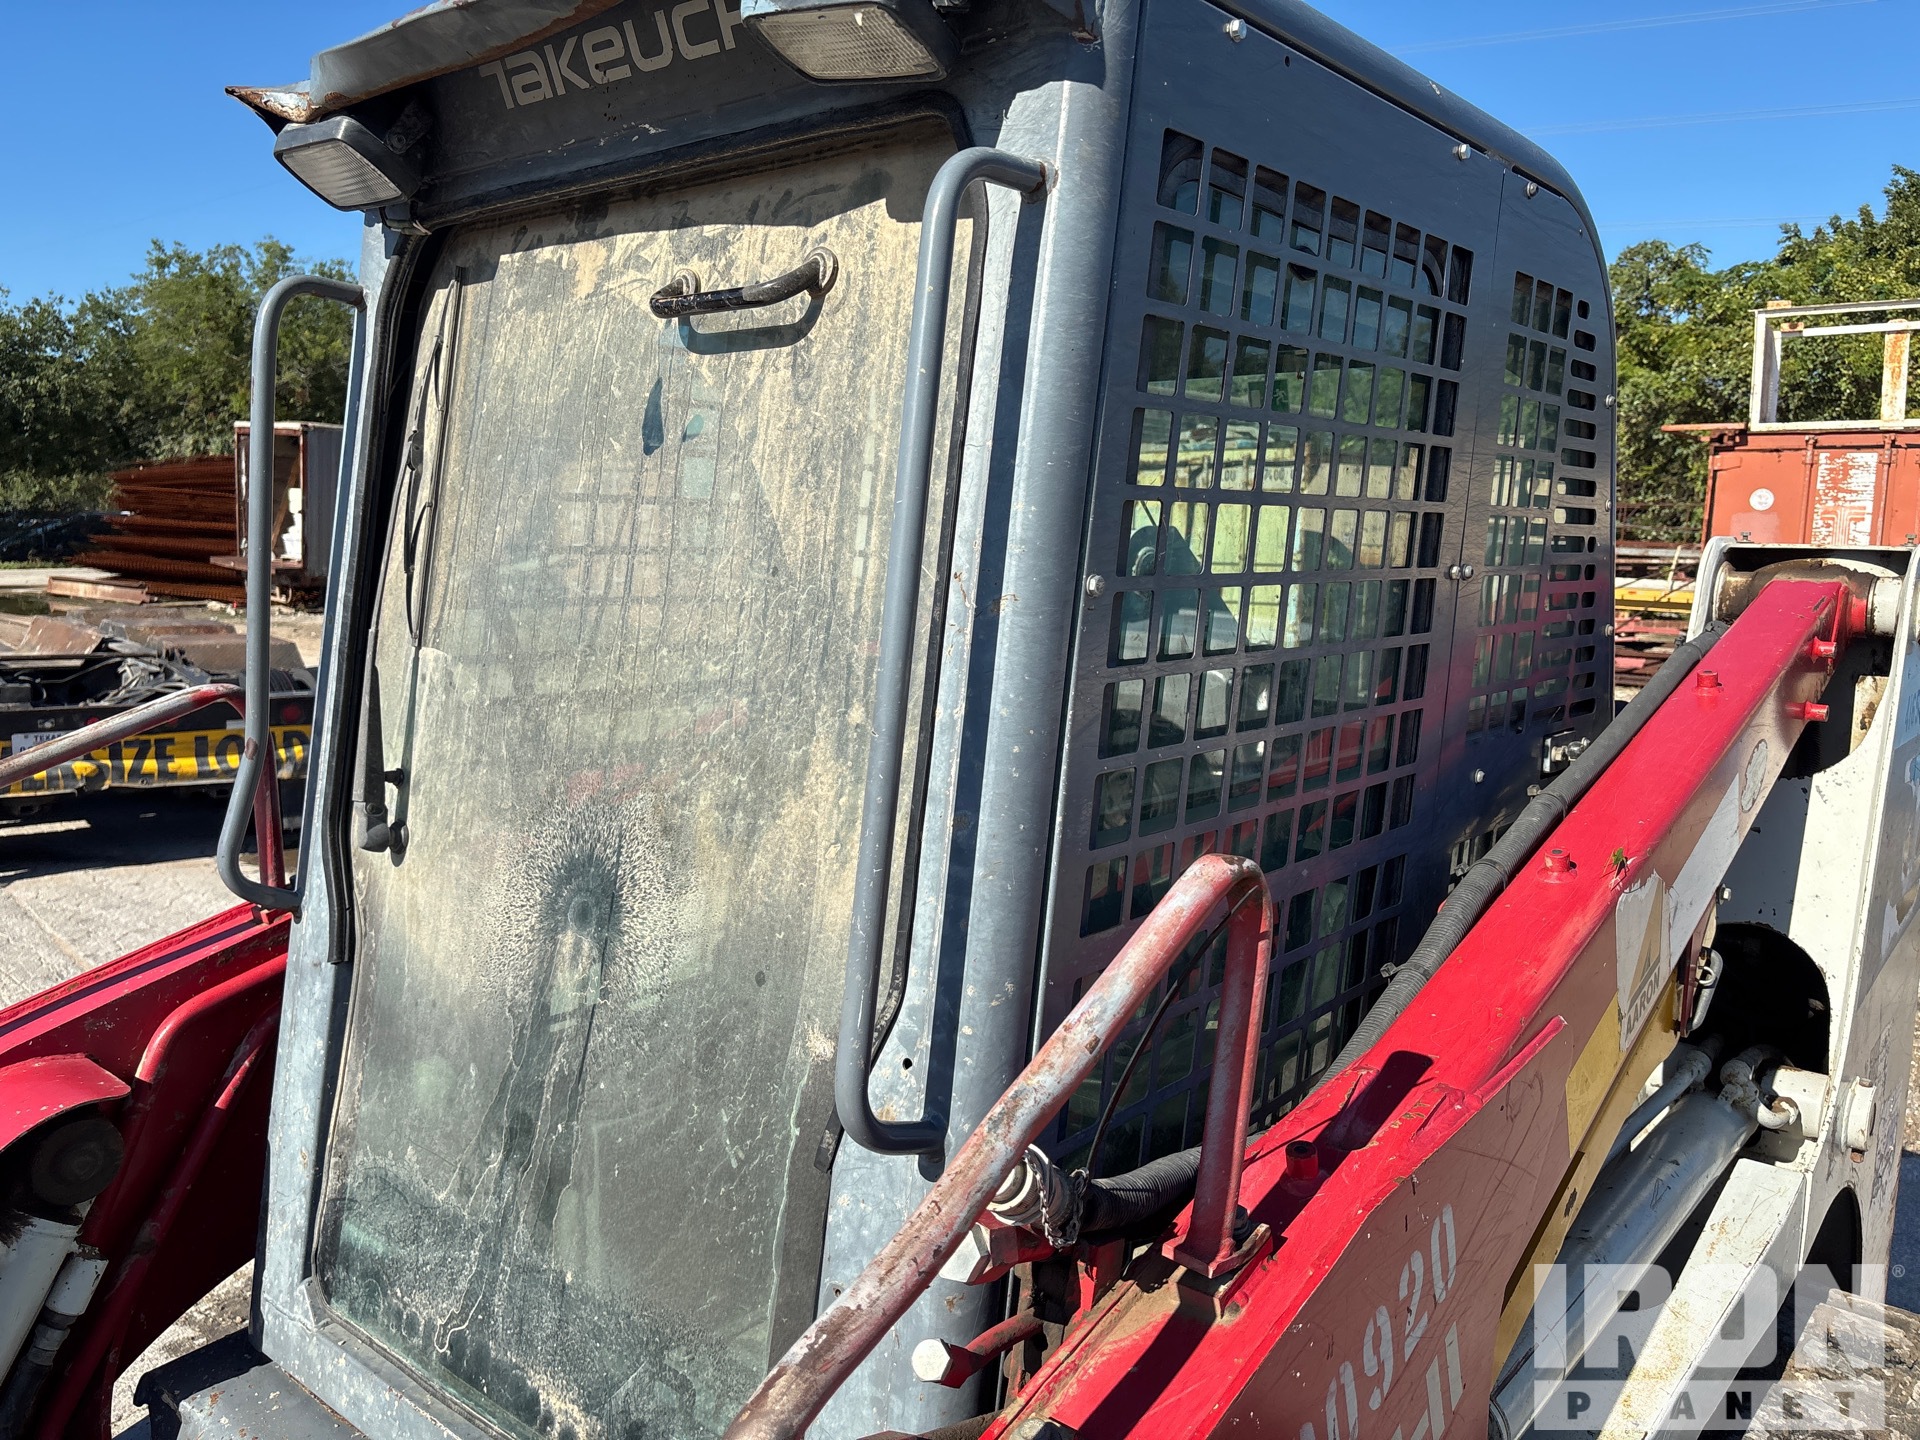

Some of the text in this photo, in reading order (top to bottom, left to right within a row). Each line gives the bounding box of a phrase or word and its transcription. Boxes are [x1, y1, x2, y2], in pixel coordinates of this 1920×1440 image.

[194, 730, 311, 778] LOD
[1625, 965, 1660, 1043] AARON
[1300, 1204, 1456, 1440] 0920
